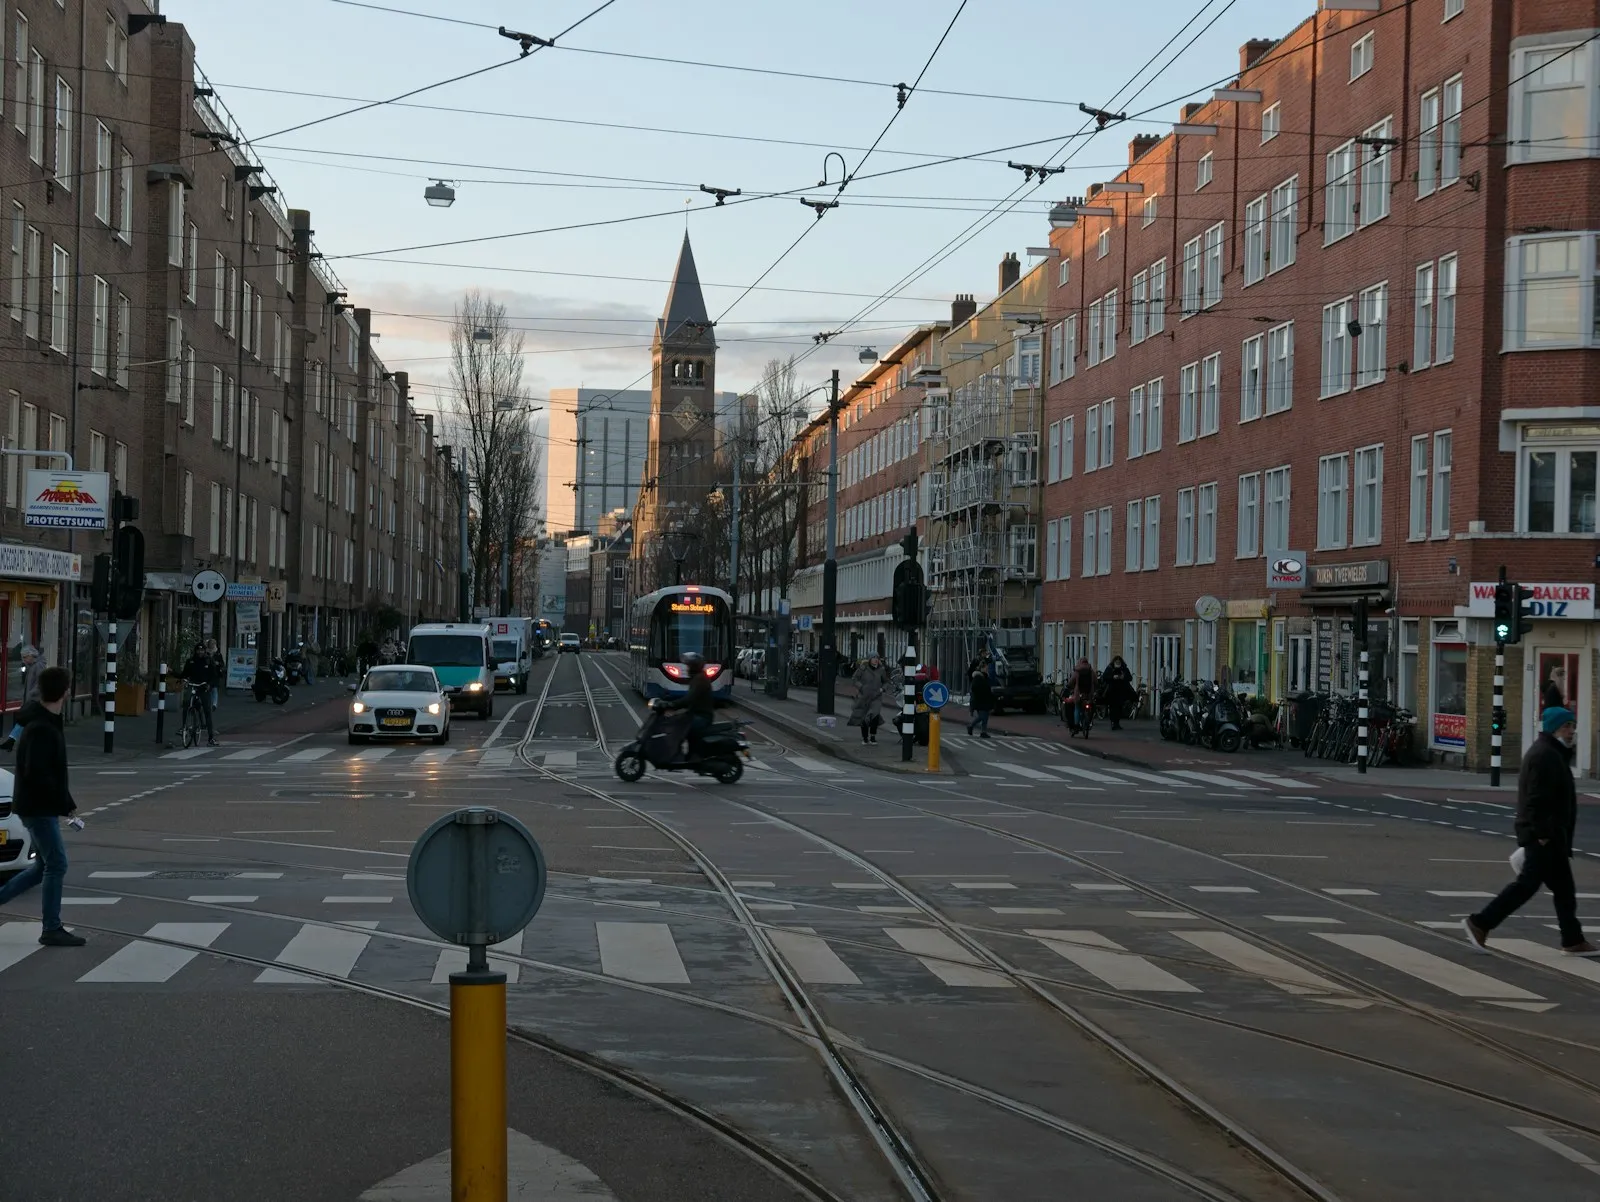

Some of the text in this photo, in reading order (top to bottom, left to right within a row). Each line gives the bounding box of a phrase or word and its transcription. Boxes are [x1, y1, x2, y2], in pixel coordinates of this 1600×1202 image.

[27, 516, 104, 528] PROTECTSUN.nl
[1533, 586, 1591, 600] BAKKER
[671, 603, 690, 611] Station
